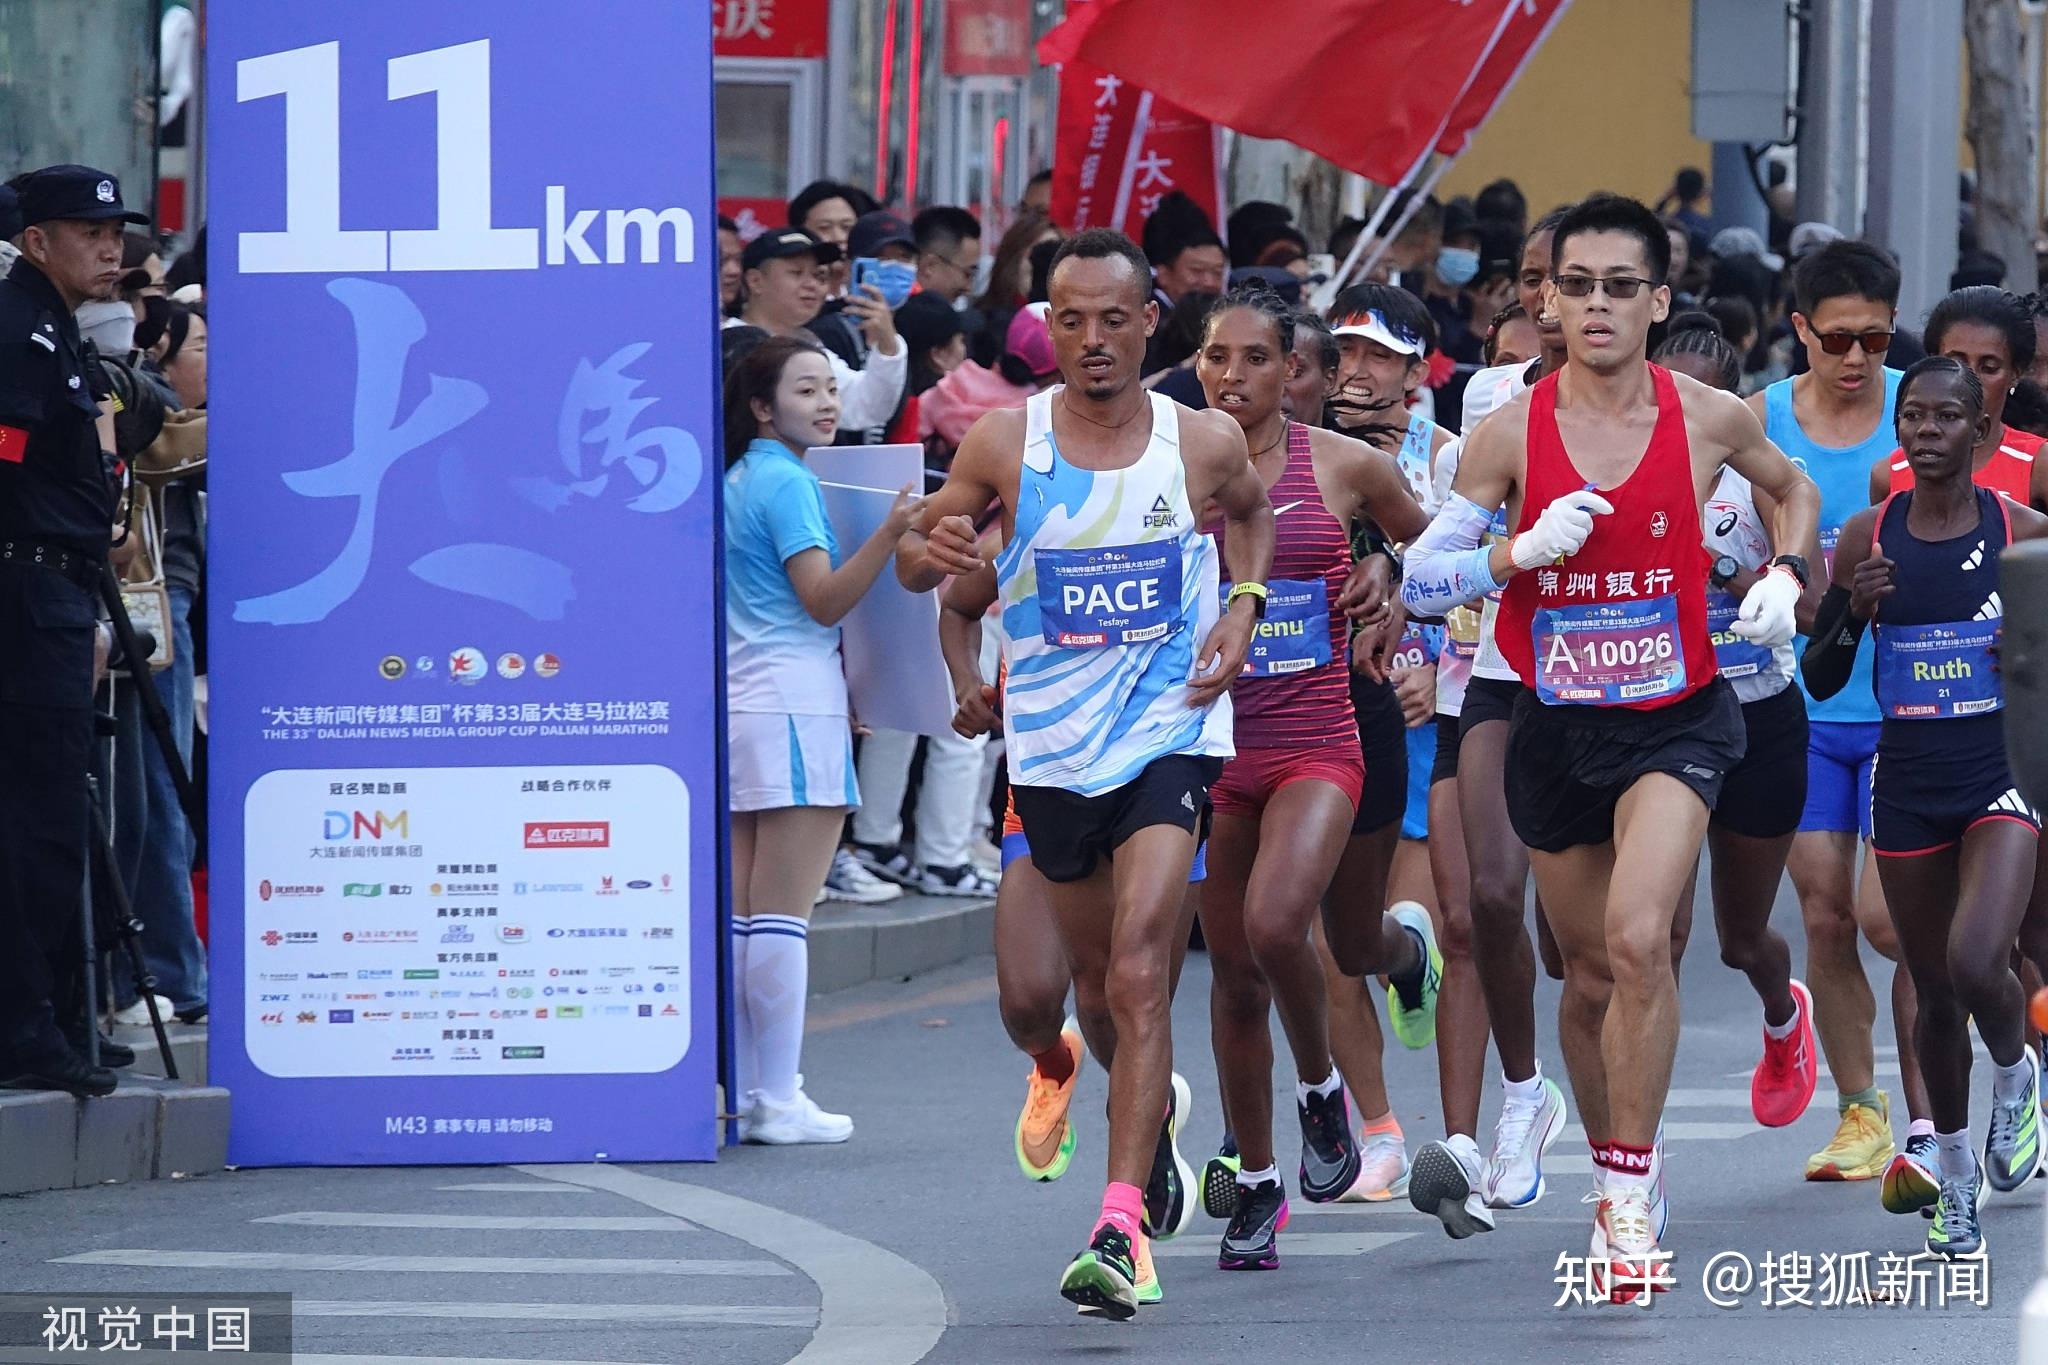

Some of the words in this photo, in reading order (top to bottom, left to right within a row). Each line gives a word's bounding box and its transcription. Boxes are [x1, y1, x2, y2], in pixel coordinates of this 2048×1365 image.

[1143, 514, 1179, 528] PEAK
[1063, 578, 1160, 615] PACE
[1098, 617, 1130, 627] Tesfaye
[1254, 647, 1267, 656] 22
[1545, 634, 1579, 673] A
[1583, 632, 1673, 668] 10026
[1913, 657, 1972, 681] Ruth
[1938, 688, 1950, 698] 21
[263, 729, 289, 740] THE
[318, 728, 367, 739] DALIAN
[369, 727, 409, 739] NEWS
[412, 726, 455, 738] MEDIA
[457, 726, 506, 738] GROUP
[509, 725, 537, 737] CUP
[540, 724, 590, 736] DALIAN
[592, 723, 669, 736] MARATHON
[521, 779, 612, 792] 战略合作伙伴
[324, 810, 409, 841] DNM
[310, 845, 423, 859] 大连新闻传媒集团
[385, 1116, 427, 1134] M43
